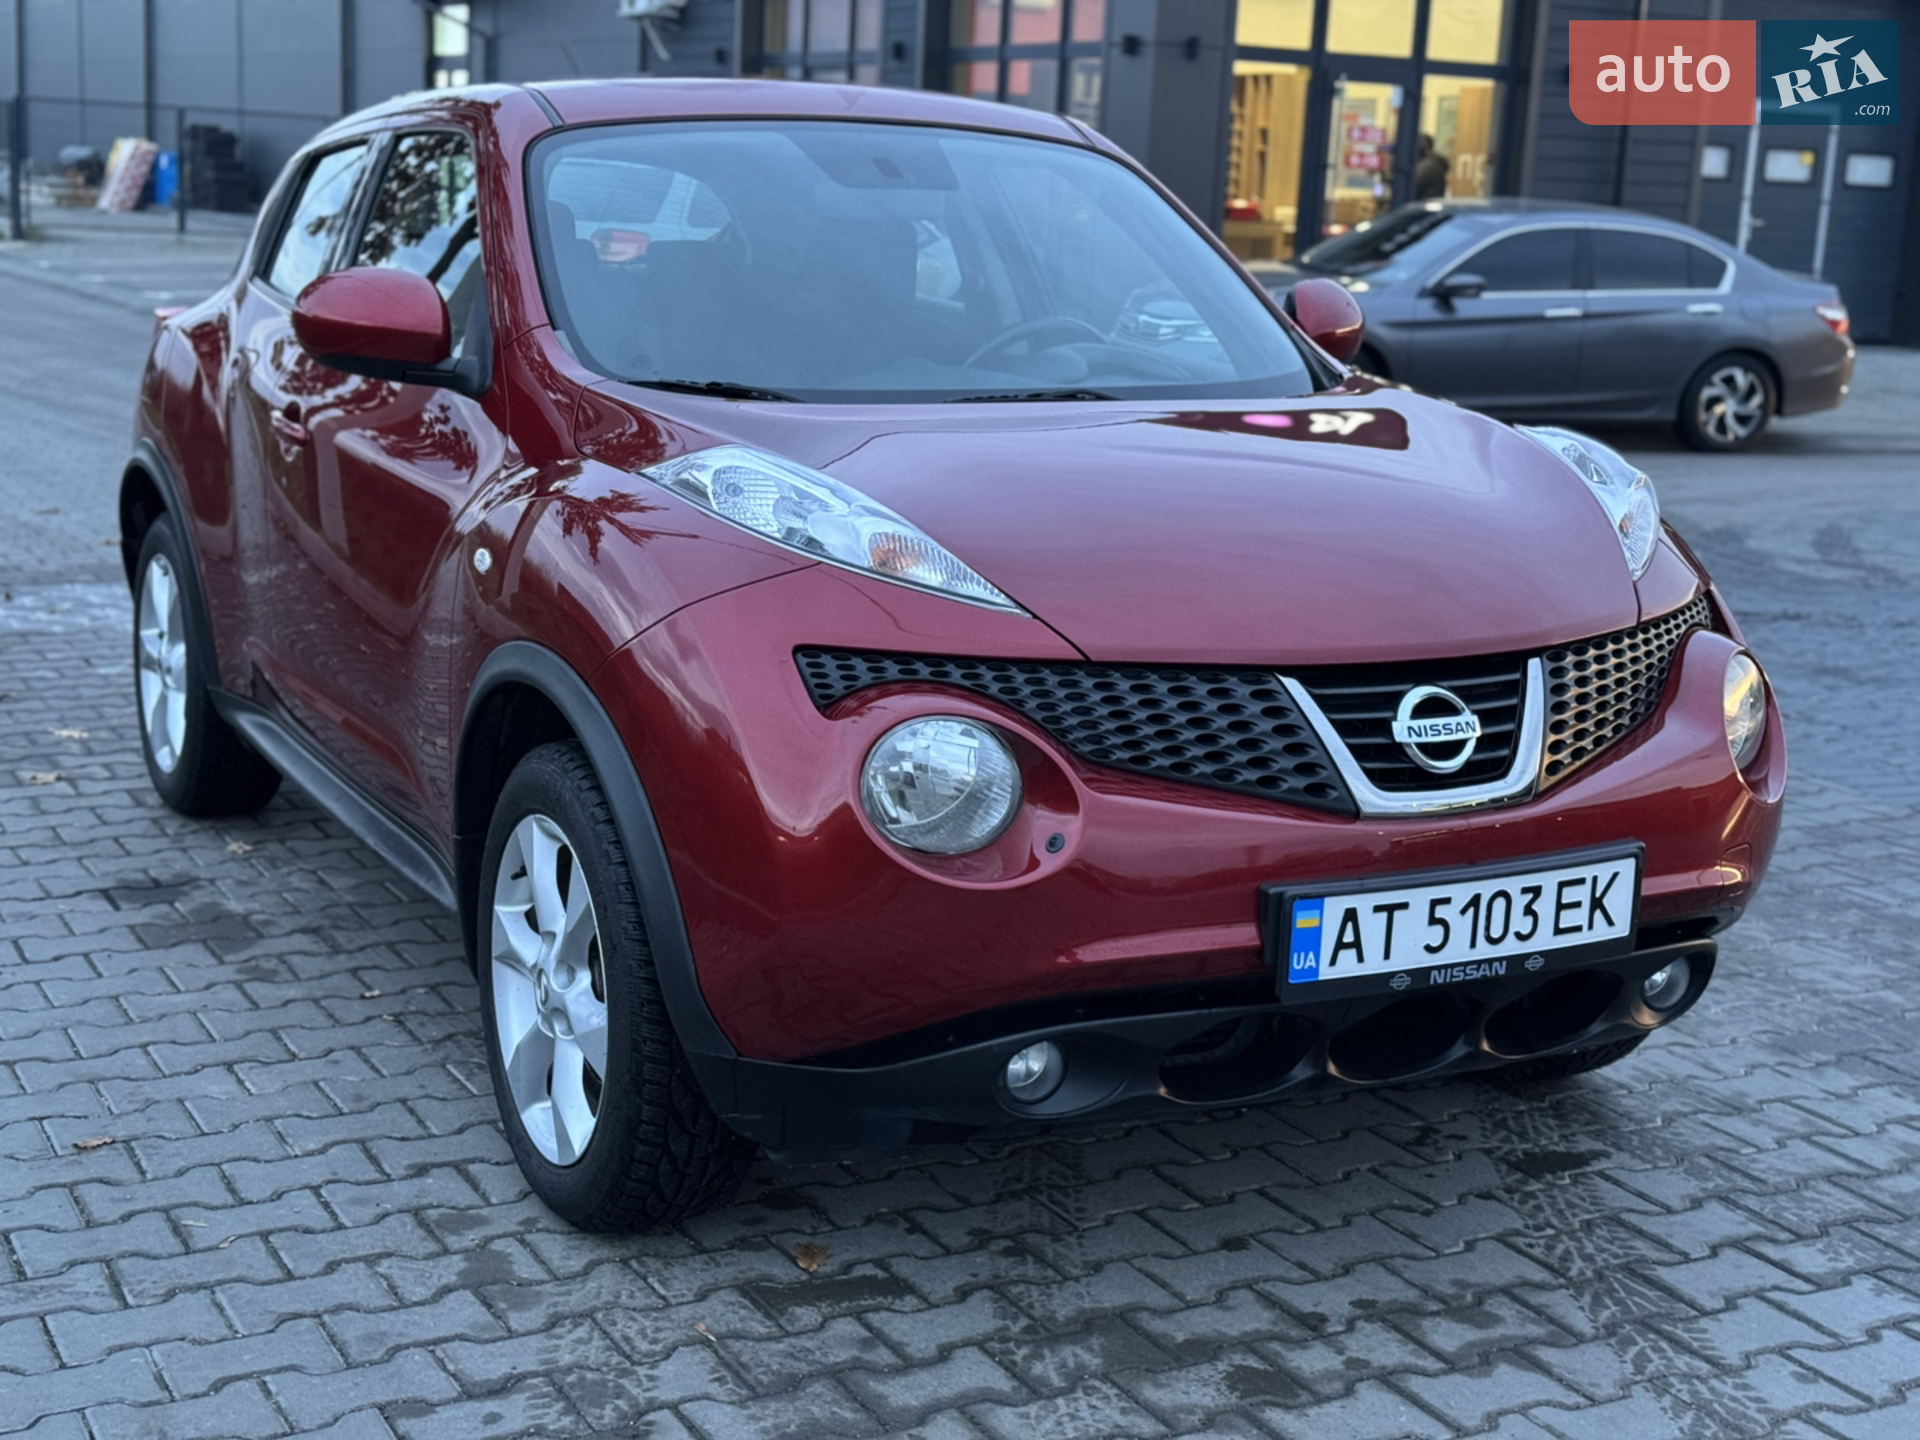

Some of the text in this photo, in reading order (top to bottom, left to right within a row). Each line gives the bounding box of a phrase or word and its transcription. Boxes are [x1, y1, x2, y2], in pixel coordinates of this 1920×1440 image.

[1406, 720, 1477, 738] NISSAN
[1328, 870, 1621, 968] AT 5103 EK
[1293, 951, 1317, 970] UA
[1429, 960, 1507, 985] NISSAN
